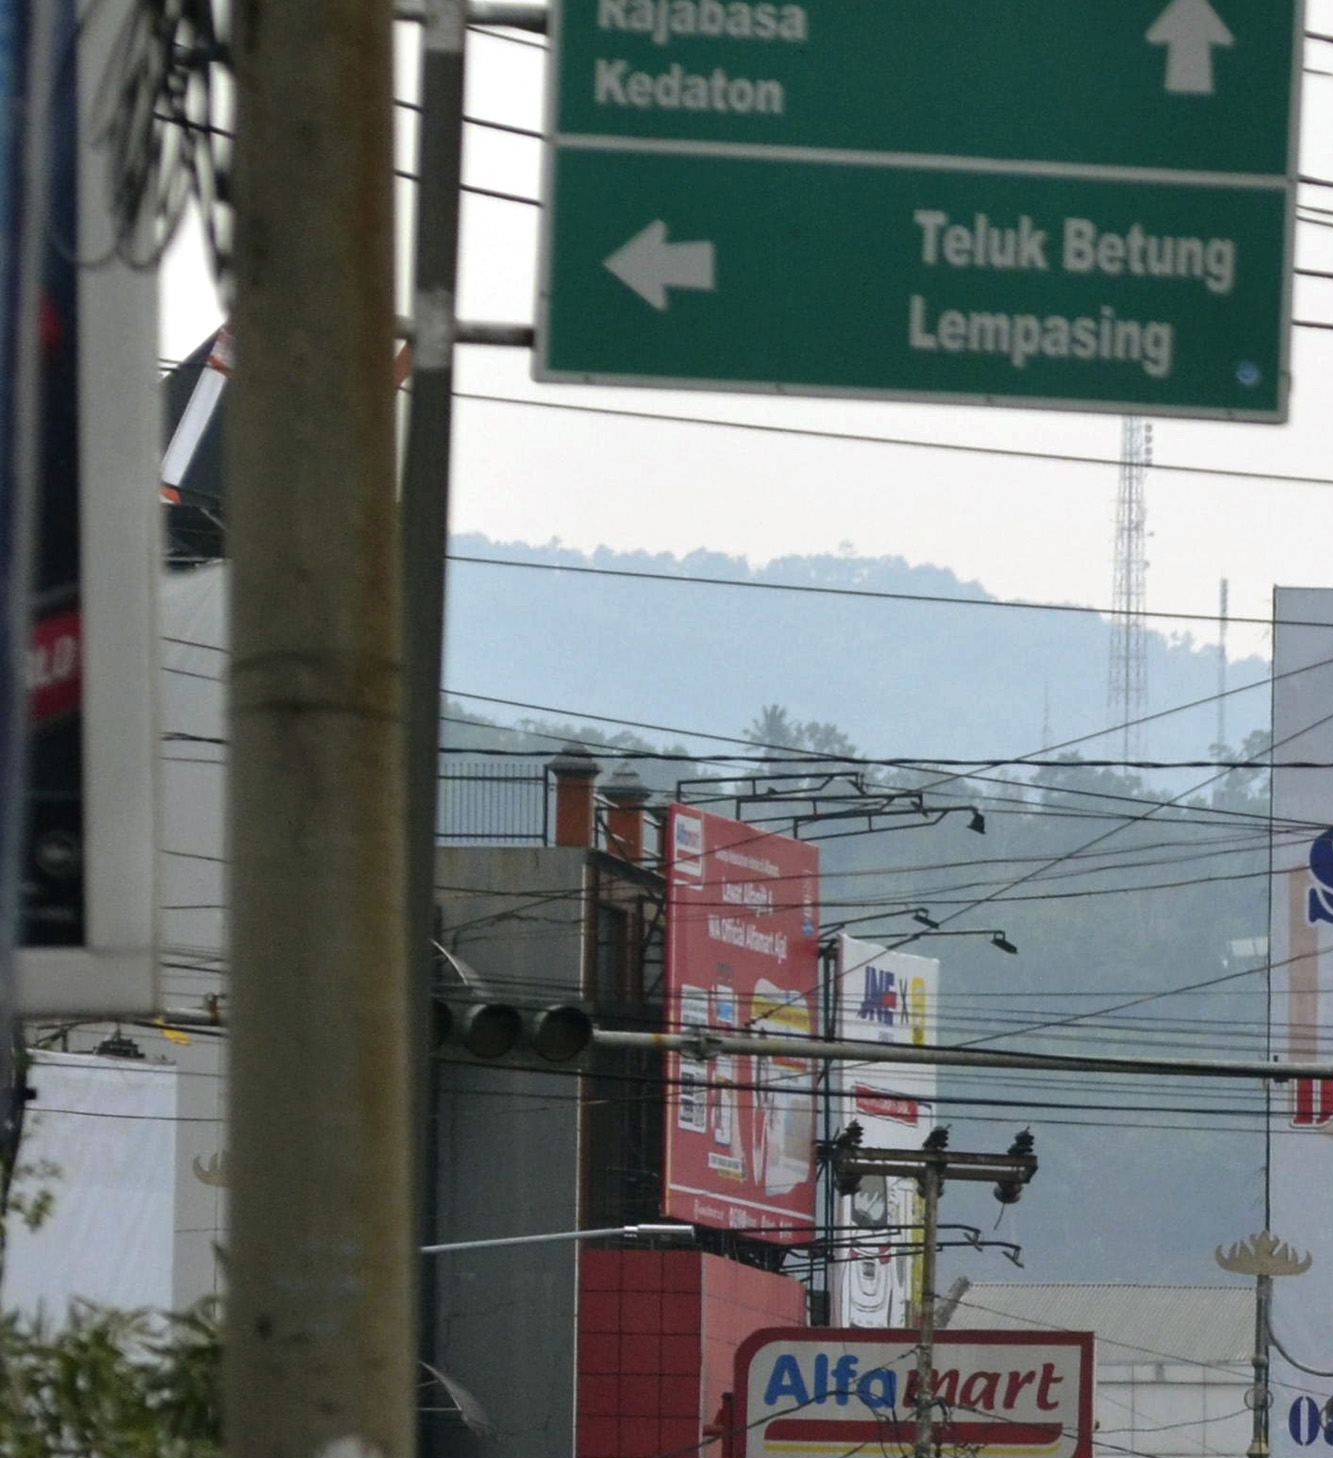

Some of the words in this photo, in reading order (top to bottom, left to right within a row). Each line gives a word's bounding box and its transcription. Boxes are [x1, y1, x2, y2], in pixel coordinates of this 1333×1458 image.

[598, 0, 808, 45] Rajabasa
[594, 58, 786, 114] Kedaton
[914, 209, 1048, 271] Teluk
[1063, 218, 1236, 294] Betung
[909, 294, 1174, 379] Lempasing
[763, 1353, 1064, 1411] Alfamart
